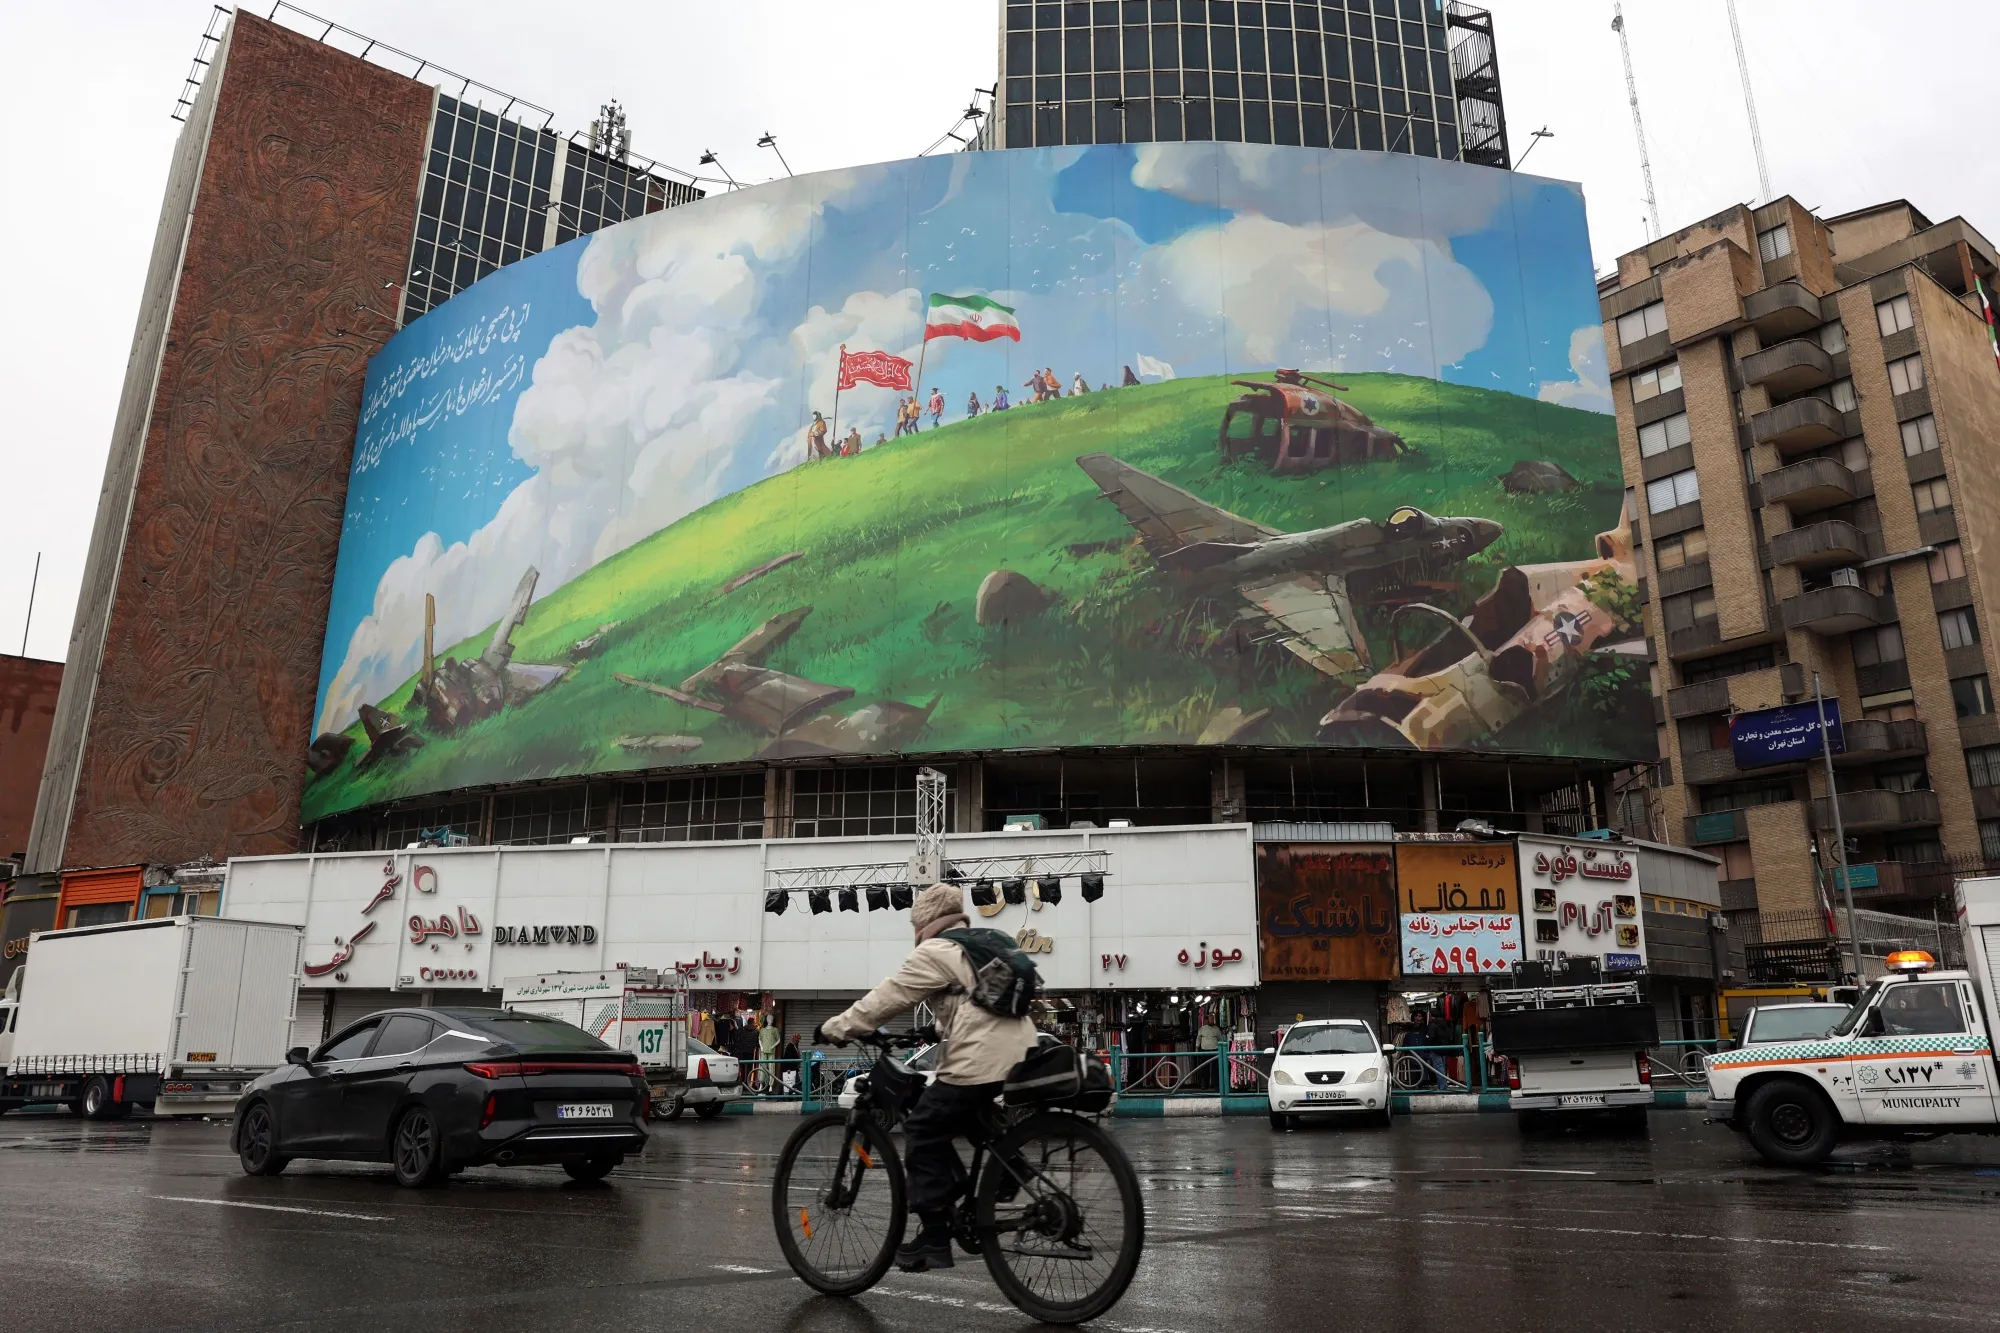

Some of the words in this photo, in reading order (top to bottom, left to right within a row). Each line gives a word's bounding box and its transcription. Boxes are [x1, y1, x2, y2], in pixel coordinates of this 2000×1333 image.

[1817, 719, 1835, 729] اداه
[1737, 731, 1758, 742] تجارت
[1768, 739, 1786, 751] تهران
[1786, 736, 1805, 748] استان
[1461, 853, 1506, 868] فروشگاه
[1535, 846, 1578, 882] فود
[1580, 849, 1633, 880] فست
[361, 858, 402, 915] شهر
[1408, 916, 1439, 937] زنانه
[1441, 915, 1485, 936] اجناس
[1488, 916, 1513, 934] کلیه
[1560, 899, 1613, 937] آرام
[408, 905, 481, 952] بامبو
[303, 920, 377, 982] کیف
[1500, 940, 1517, 951] فقط
[1101, 953, 1128, 971] ۲۷
[1177, 941, 1243, 969] موزه
[1431, 946, 1517, 975] ۵۹۹۰۰
[516, 986, 530, 996] تهران
[530, 985, 551, 995] شهرداری
[562, 984, 576, 994] شهری
[577, 984, 595, 993] مدیریت
[595, 983, 610, 991] سامانه
[638, 1029, 664, 1054] 137
[1881, 1097, 1961, 1109] MUNICIPALTY
